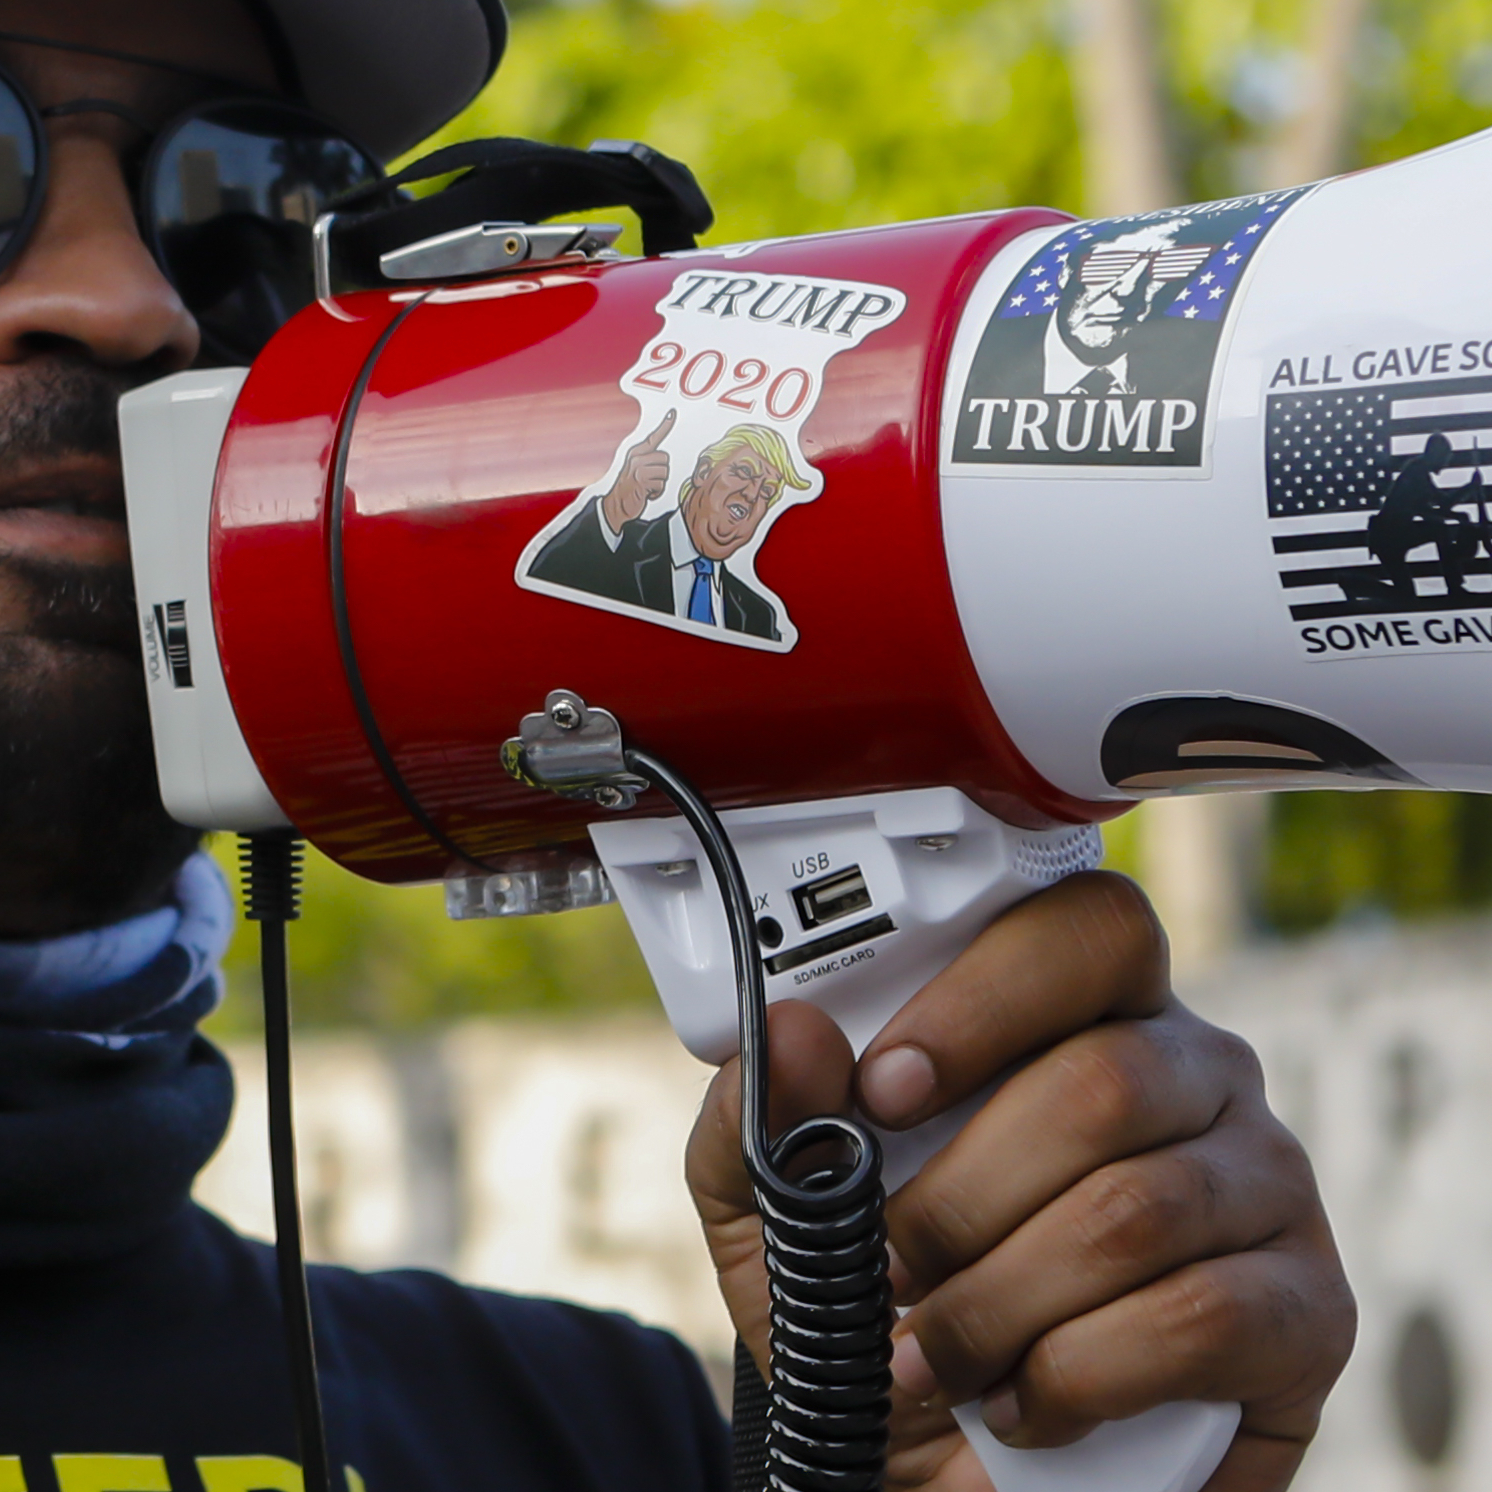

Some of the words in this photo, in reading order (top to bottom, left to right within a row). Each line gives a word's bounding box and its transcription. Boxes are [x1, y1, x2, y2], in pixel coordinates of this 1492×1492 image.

[668, 274, 896, 338] TRUMP
[632, 341, 814, 422] 2020
[1268, 354, 1343, 389] ALL
[1352, 342, 1453, 381] GAVE
[968, 397, 1198, 453] TRUMP
[142, 614, 161, 683] VOLUME
[1300, 619, 1421, 654] SOME
[791, 851, 830, 879] USB
[793, 960, 841, 986] SD/MMC
[841, 948, 876, 968] CARD
